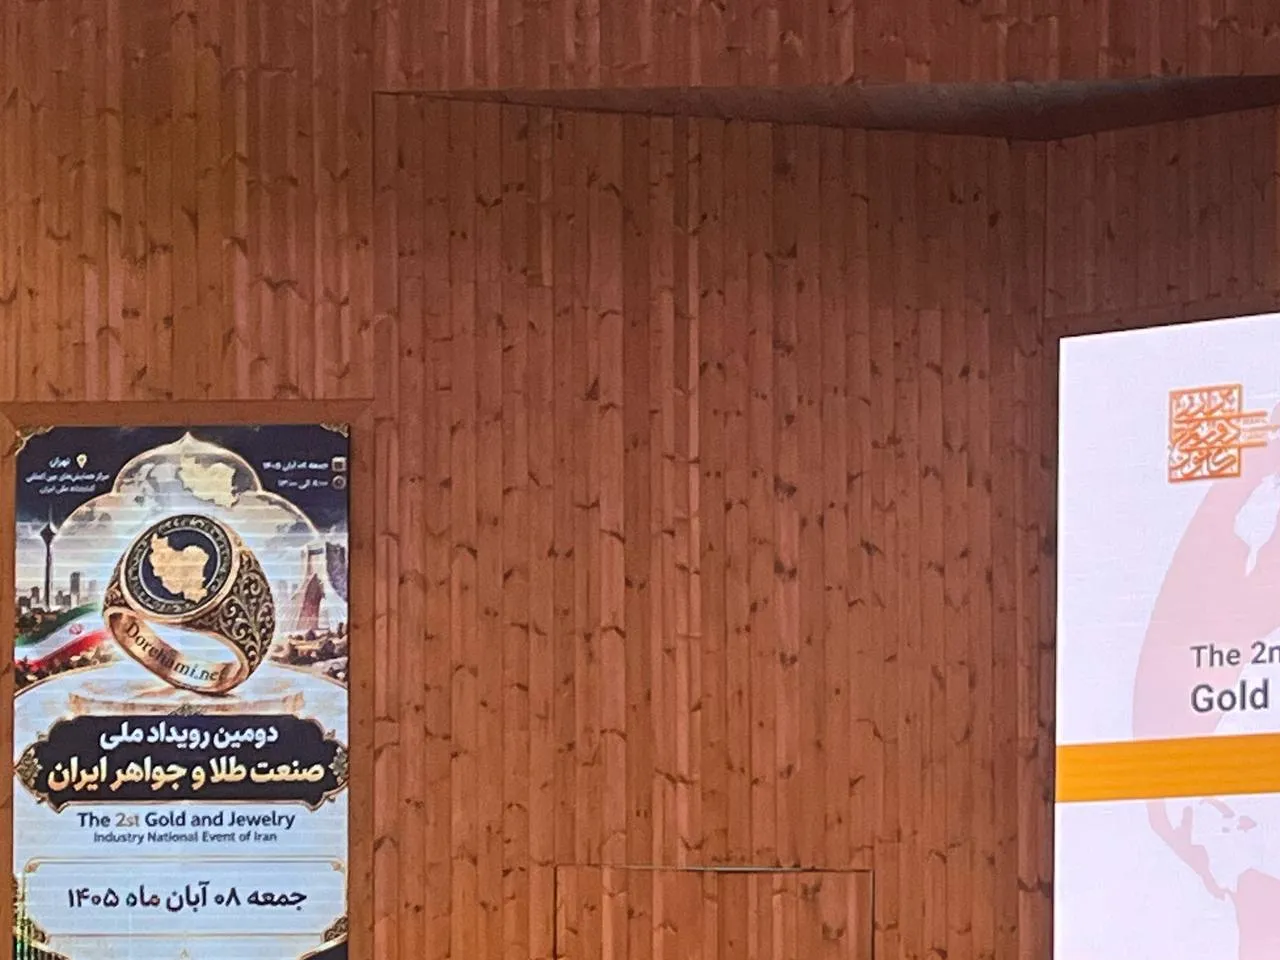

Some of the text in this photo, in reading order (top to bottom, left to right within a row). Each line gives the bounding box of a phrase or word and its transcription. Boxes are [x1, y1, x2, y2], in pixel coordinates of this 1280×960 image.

[1190, 643, 1241, 668] The
[1190, 678, 1270, 713] Gold
[100, 721, 278, 750] دومین رویداد ملی
[48, 755, 325, 791] صنعت طلا و جواهر ایران
[77, 811, 111, 828] The
[144, 811, 186, 828] Gold
[190, 811, 223, 827] and
[228, 810, 296, 830] Jewelry
[93, 831, 278, 846] Industry National Event of Iran
[67, 881, 307, 912] جمعه ۰۸ آبان ماه ۱۴۰۵
